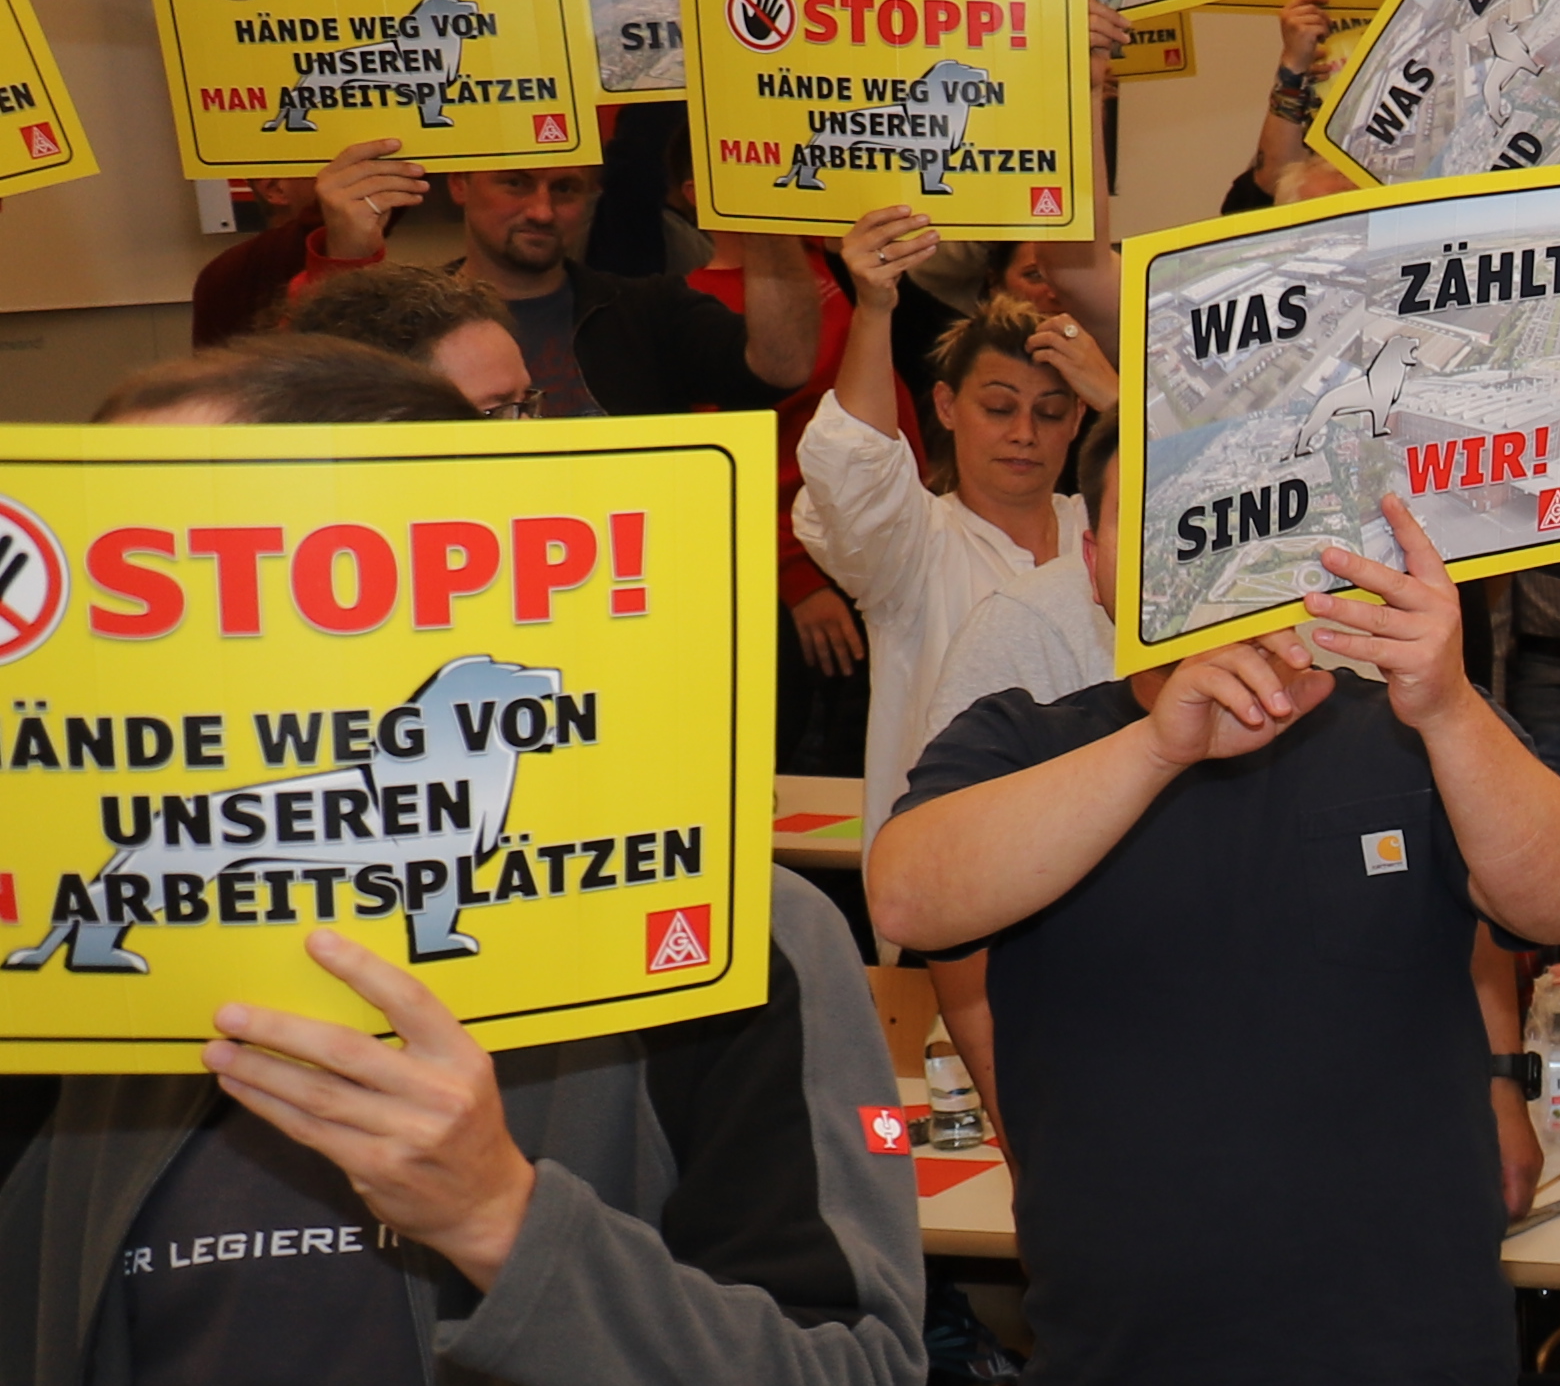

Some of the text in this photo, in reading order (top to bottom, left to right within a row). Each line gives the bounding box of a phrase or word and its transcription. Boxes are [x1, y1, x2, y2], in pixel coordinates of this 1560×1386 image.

[235, 12, 497, 44] HÄNDE WEG VON
[293, 48, 444, 76] UNSEREN
[201, 75, 558, 112] MAN ARBEITSPLÄTZEN
[758, 68, 1005, 105] HÄNDE WEG VON
[1365, 58, 1435, 146] WAS
[720, 139, 1057, 173] MAN ARBEITSPLÄTZEN
[808, 111, 949, 138] UNSEREN
[1189, 285, 1308, 362] WAS
[1175, 426, 1550, 563] SIND WIR!
[84, 509, 650, 640] STOPP!
[8, 691, 599, 771] ÄNDE WEG VON
[100, 778, 473, 848] UNSEREN
[52, 825, 703, 927] ARBEITSPLÄTZEN
